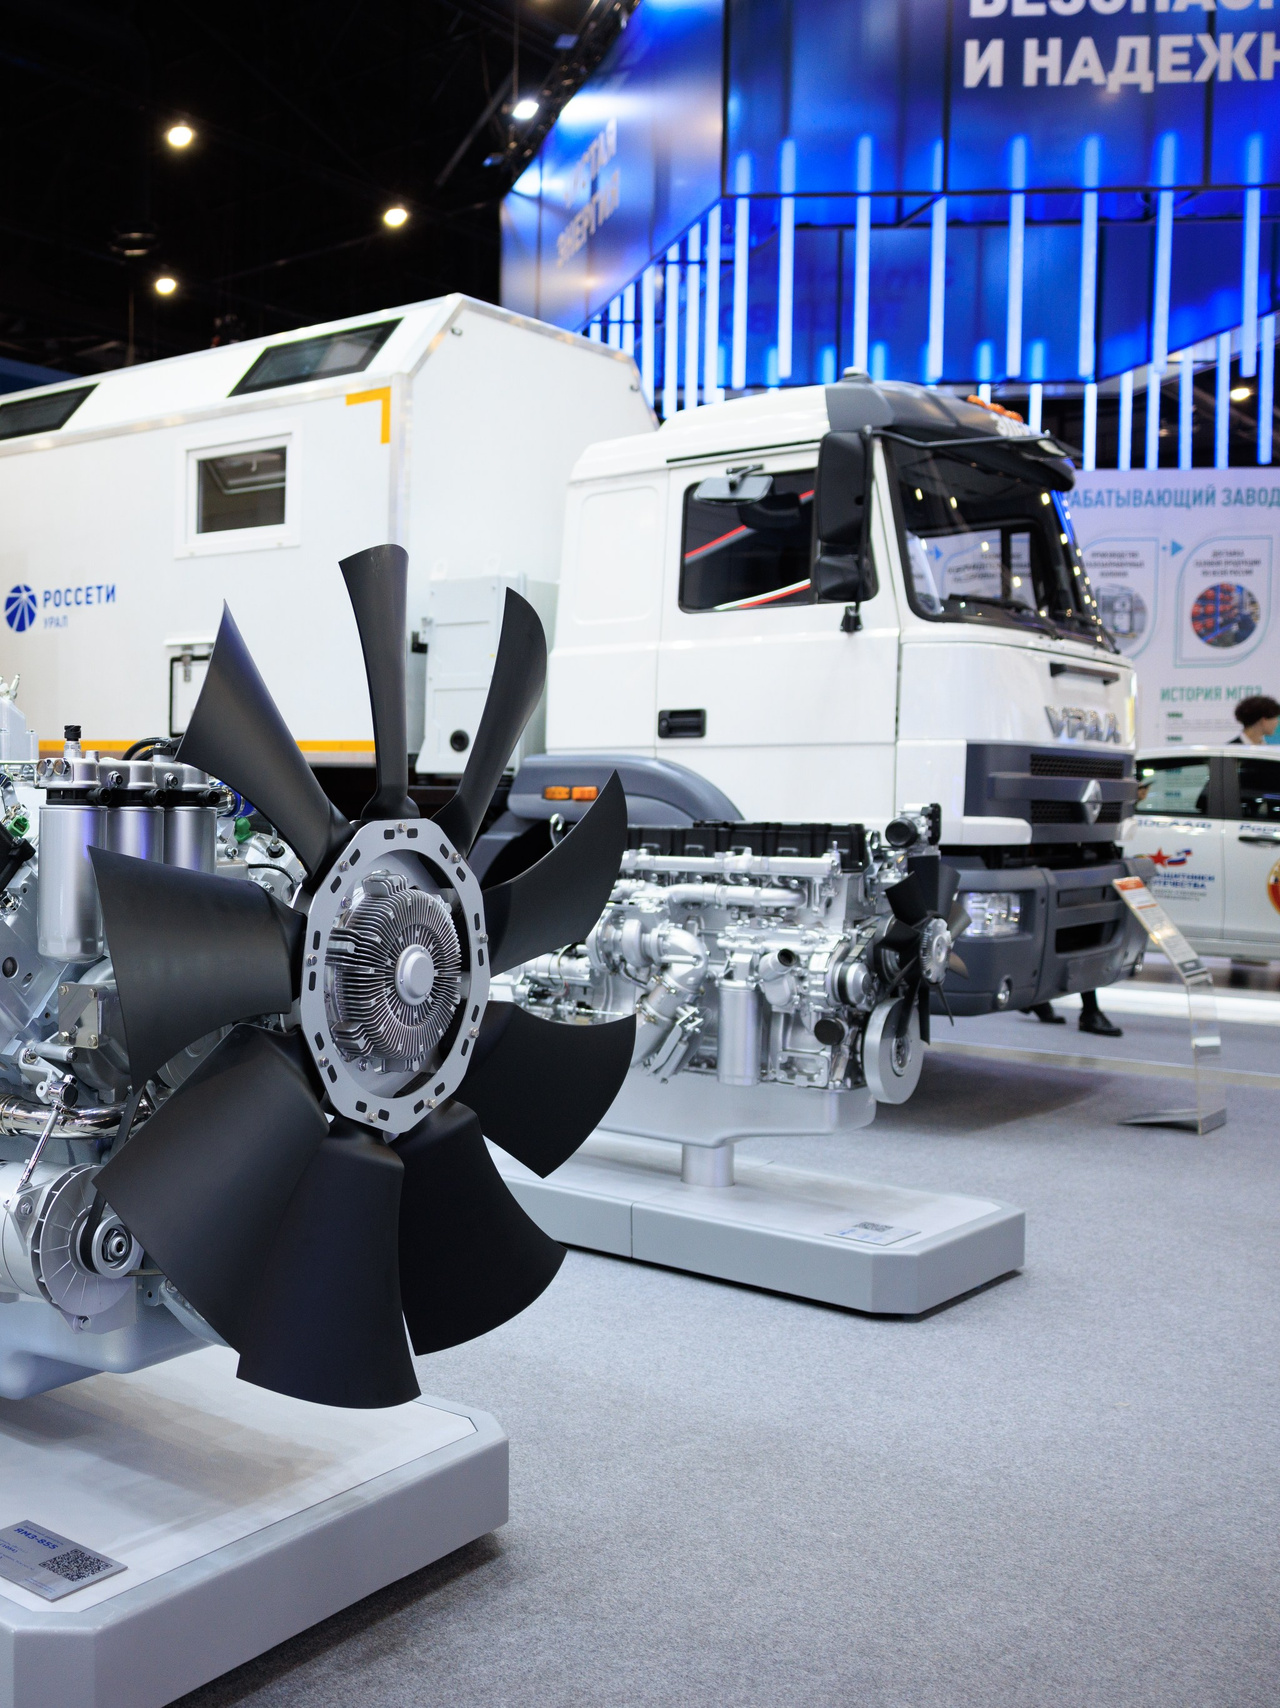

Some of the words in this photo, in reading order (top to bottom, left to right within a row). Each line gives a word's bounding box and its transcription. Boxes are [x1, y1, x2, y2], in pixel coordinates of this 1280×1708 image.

[963, 38, 1005, 88] И
[1069, 484, 1217, 509] АБАТЫВАЮЩИЙ
[42, 584, 116, 609] РОССЕТИ
[42, 614, 69, 629] УРАЛ
[1160, 685, 1222, 702] ИСТОРИЯ
[13, 1527, 59, 1550] ЯМЗ-855
